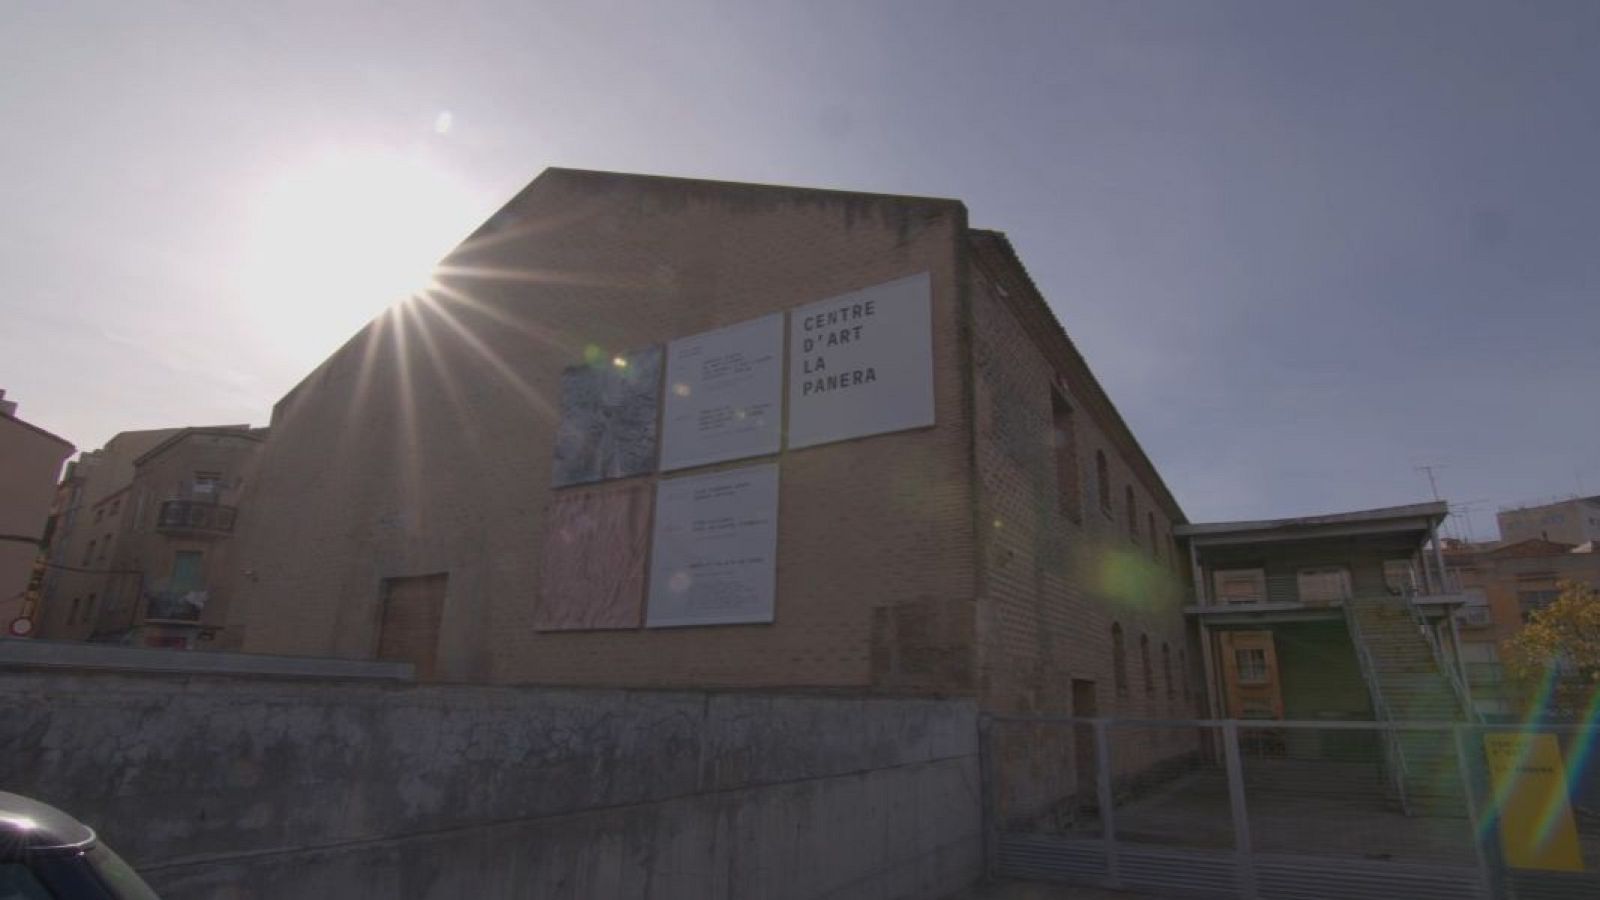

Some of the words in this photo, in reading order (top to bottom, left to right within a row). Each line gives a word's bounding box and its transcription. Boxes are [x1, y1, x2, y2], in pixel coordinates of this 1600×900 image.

[803, 300, 876, 331] CENTRE
[803, 325, 863, 353] D'ART
[803, 356, 826, 374] LA
[803, 367, 877, 395] PANERA
